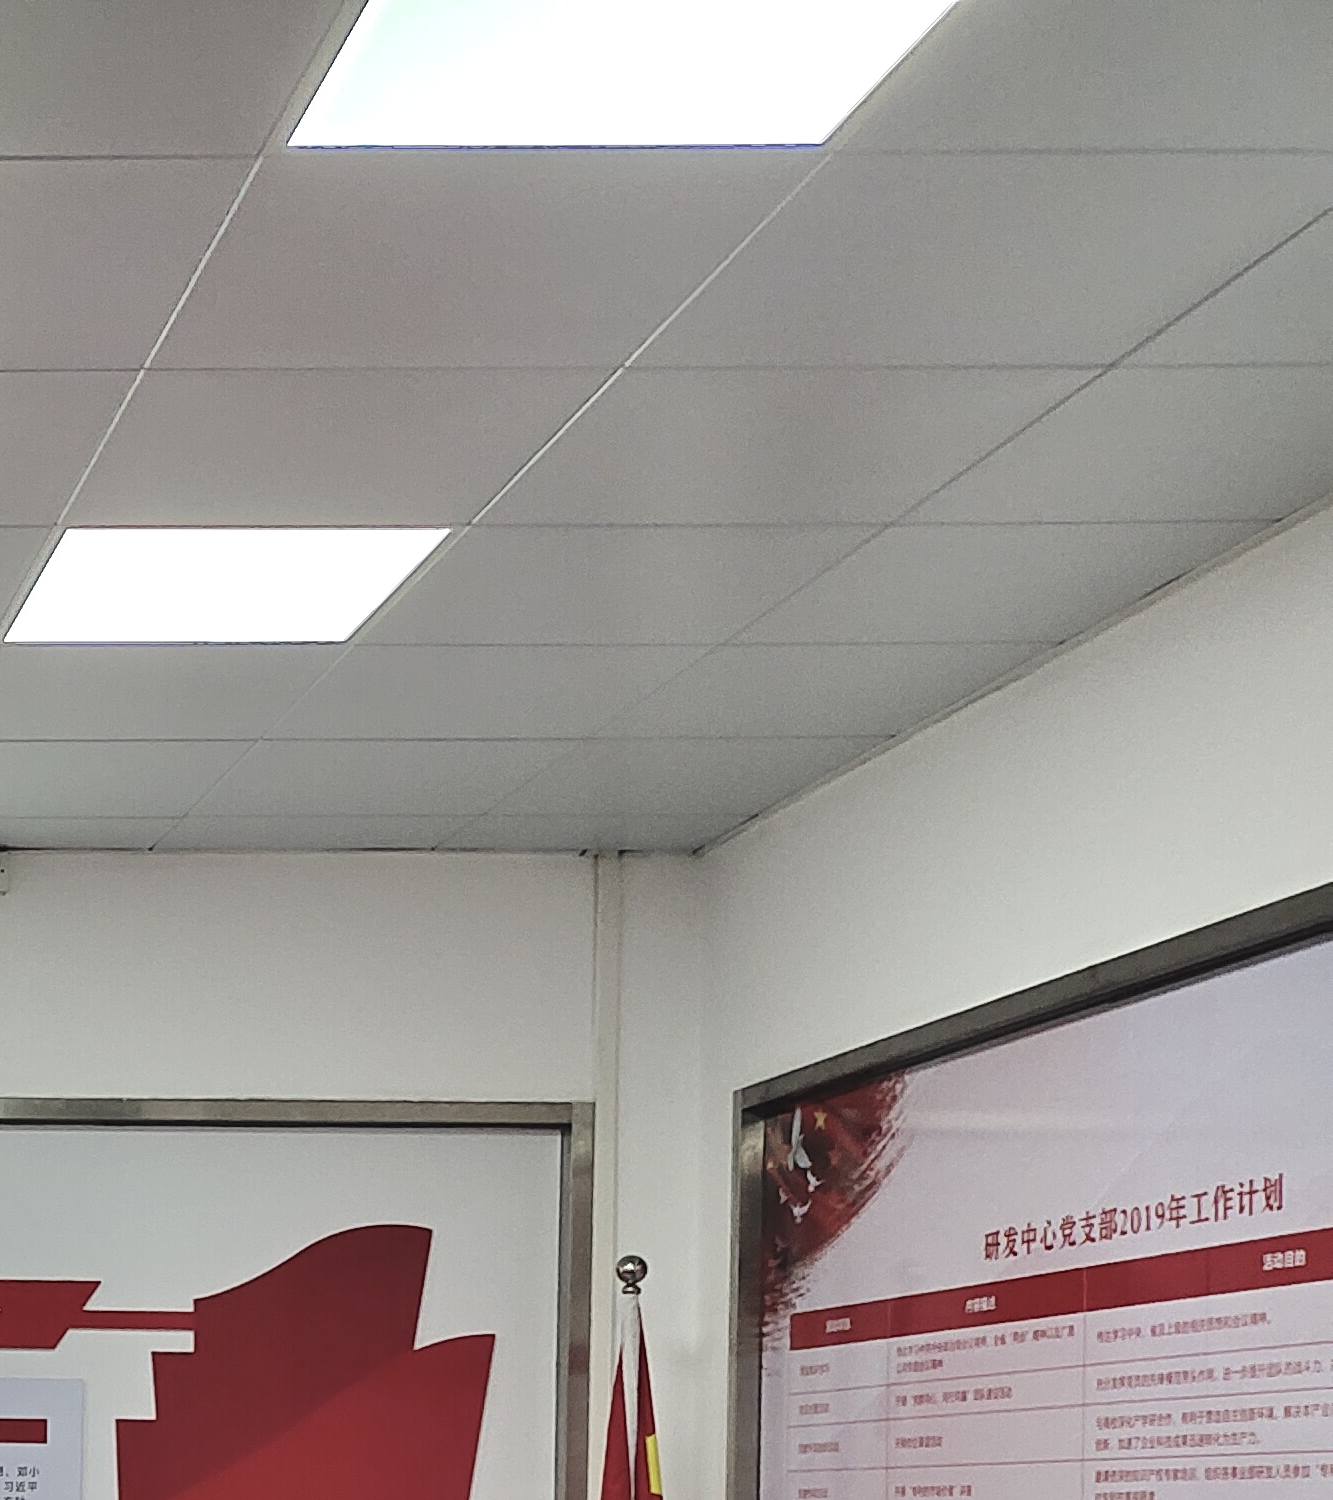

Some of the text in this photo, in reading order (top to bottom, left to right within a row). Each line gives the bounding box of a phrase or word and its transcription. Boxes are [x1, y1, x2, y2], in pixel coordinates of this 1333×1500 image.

[984, 1173, 1284, 1261] 研发中心党支部2019年工作计划
